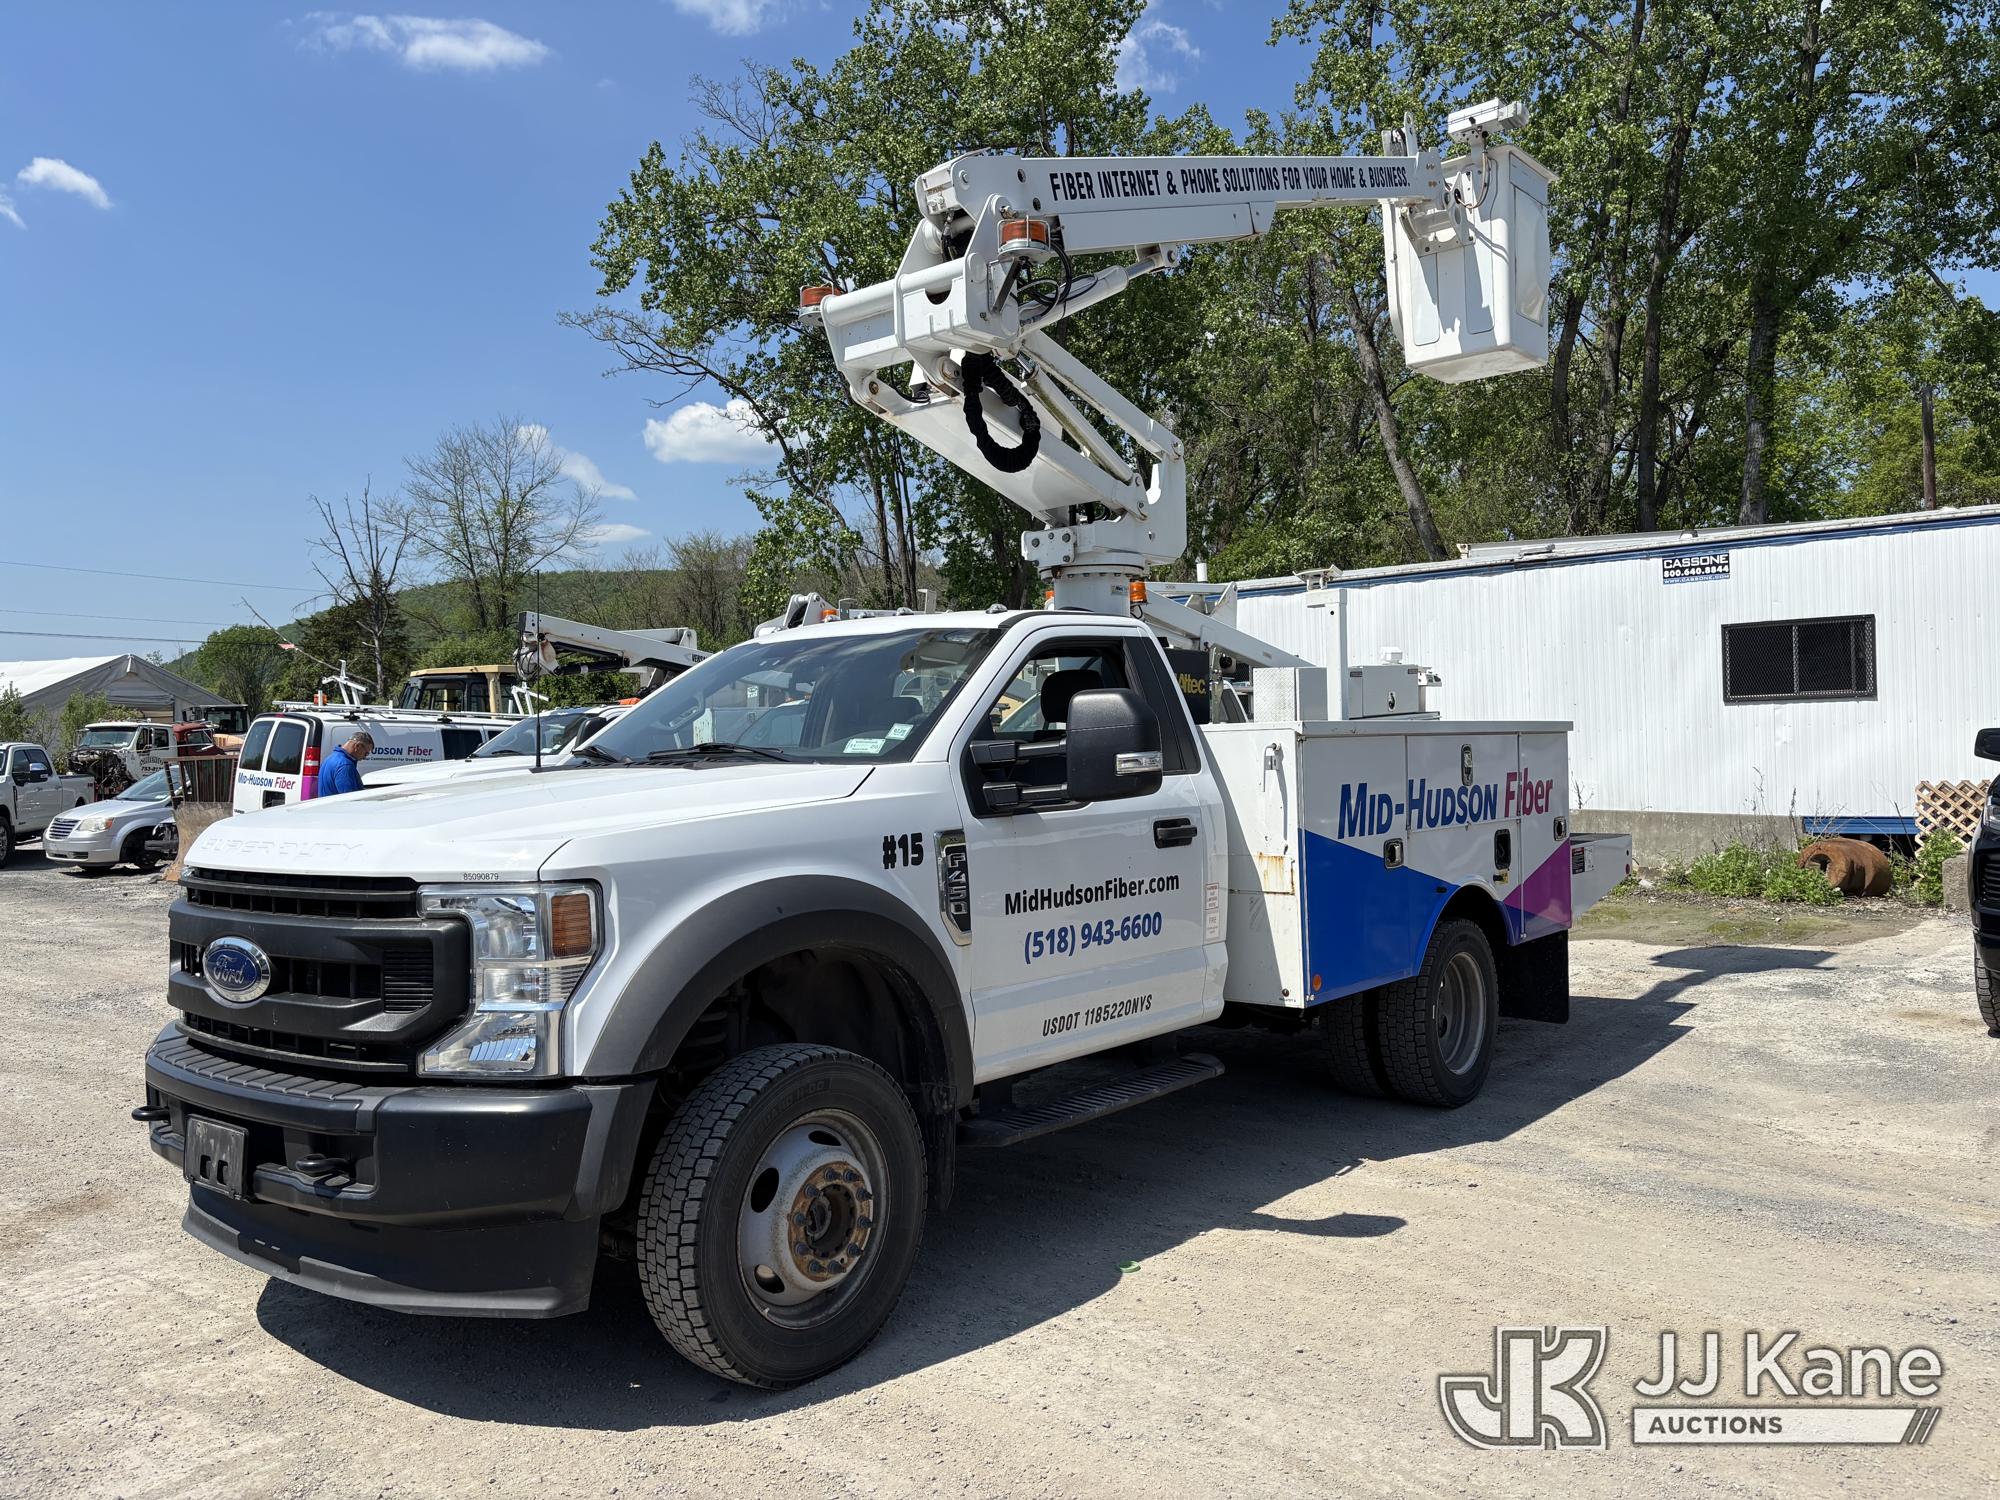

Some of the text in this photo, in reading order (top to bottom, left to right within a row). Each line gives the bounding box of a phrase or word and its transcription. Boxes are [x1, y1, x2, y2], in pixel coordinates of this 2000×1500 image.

[1049, 166, 1410, 201] FIBER INTERNET & PHONE SOLUTIONS FOR YOUR HOME & BUSINESS.
[1663, 554, 1729, 569] CASSONE
[1663, 565, 1729, 578] 800.640.8844
[407, 746, 433, 756] Fiber
[274, 776, 296, 790] Fiber
[1504, 767, 1554, 818] Fiber
[882, 832, 924, 870] #15
[1004, 874, 1180, 916] MidHudsonFiber.com
[1024, 911, 1163, 965] (518) 943-6600
[213, 953, 246, 985] Ford
[1042, 994, 1153, 1037] USDOT 1185220NYS
